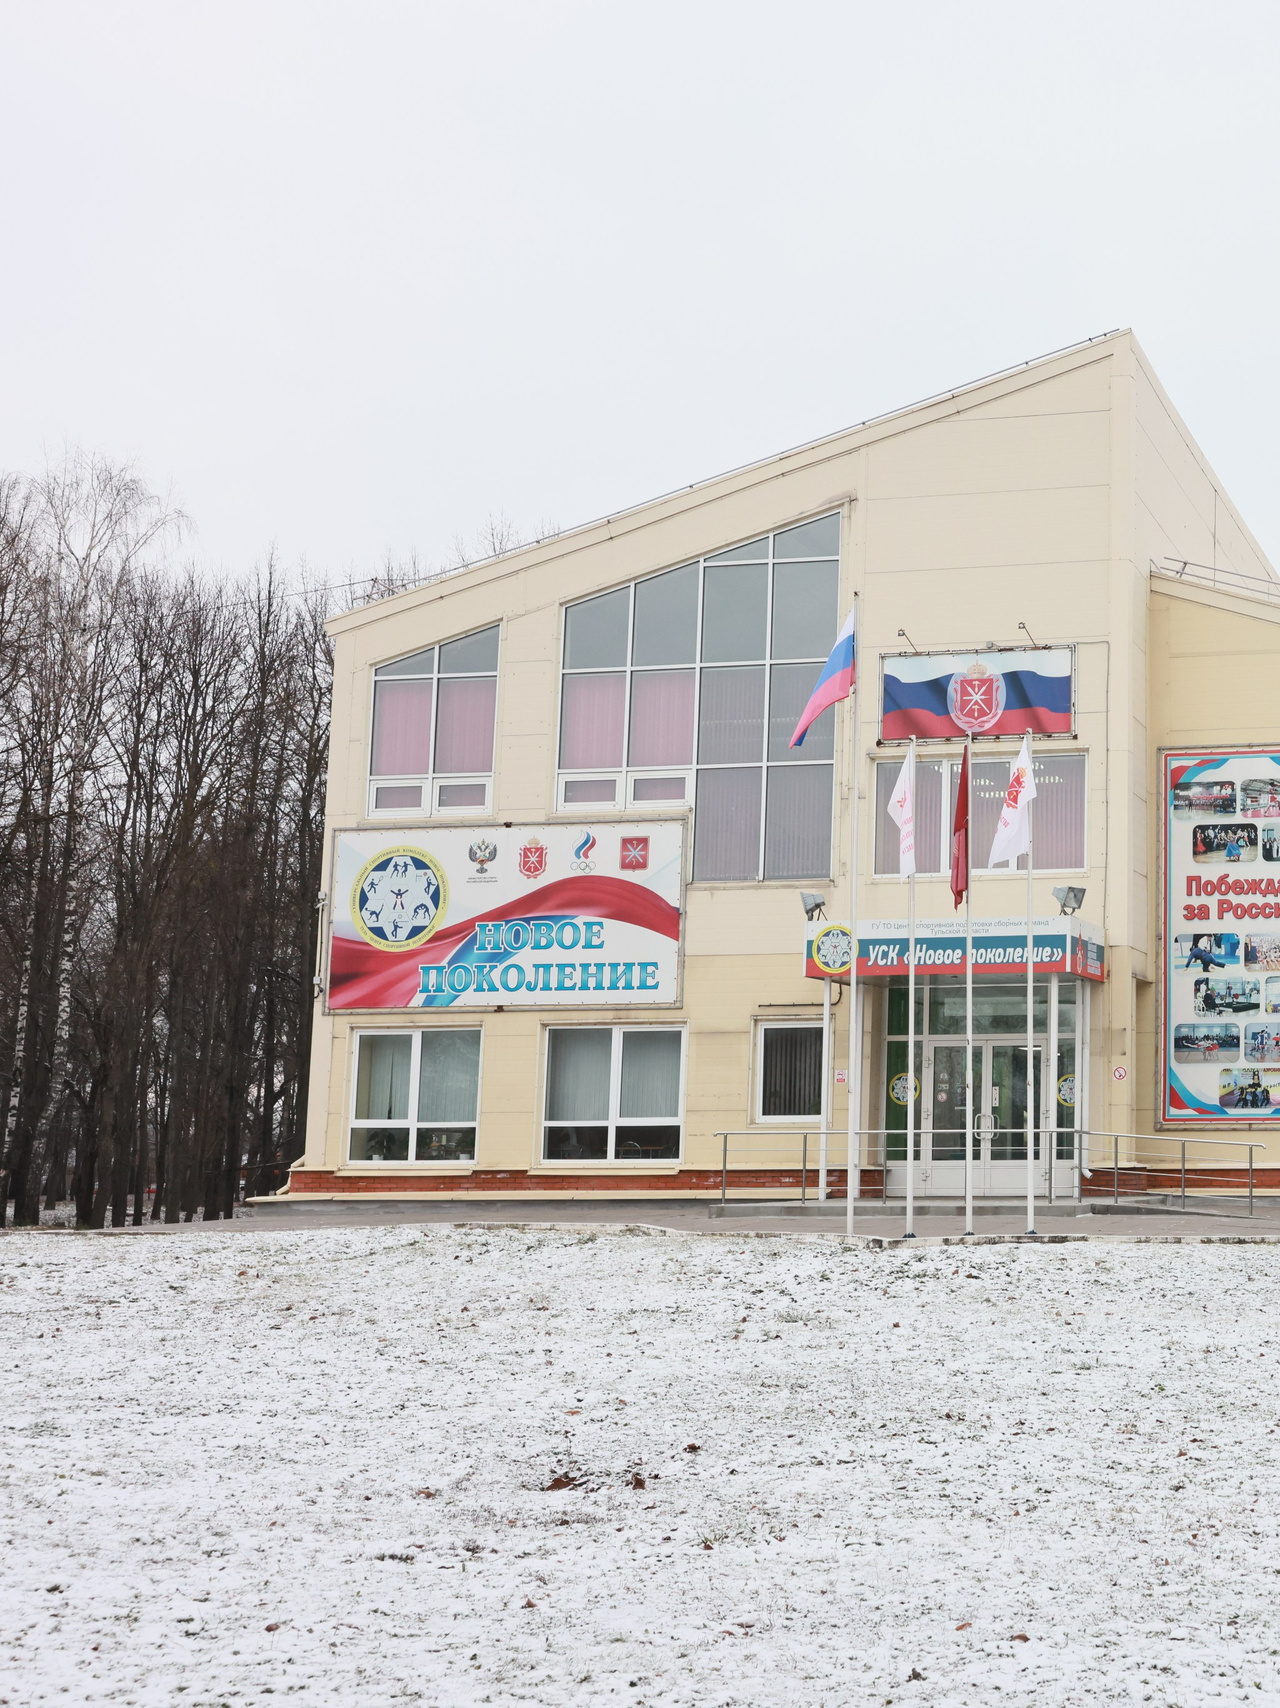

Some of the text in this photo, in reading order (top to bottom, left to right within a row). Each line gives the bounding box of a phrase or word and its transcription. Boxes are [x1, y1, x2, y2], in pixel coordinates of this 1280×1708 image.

[1182, 903, 1211, 921] за
[871, 922, 881, 930] ГУ
[882, 922, 892, 930] ТО
[915, 921, 955, 931] спортивной
[955, 920, 993, 930] подотовки
[993, 919, 1023, 929] сборных
[1024, 919, 1050, 927] кманд
[930, 927, 961, 936] Тульской
[475, 921, 605, 951] НОВОЕ
[867, 944, 900, 966] УСК
[418, 961, 660, 994] ПОКОЛЕНИЕ
